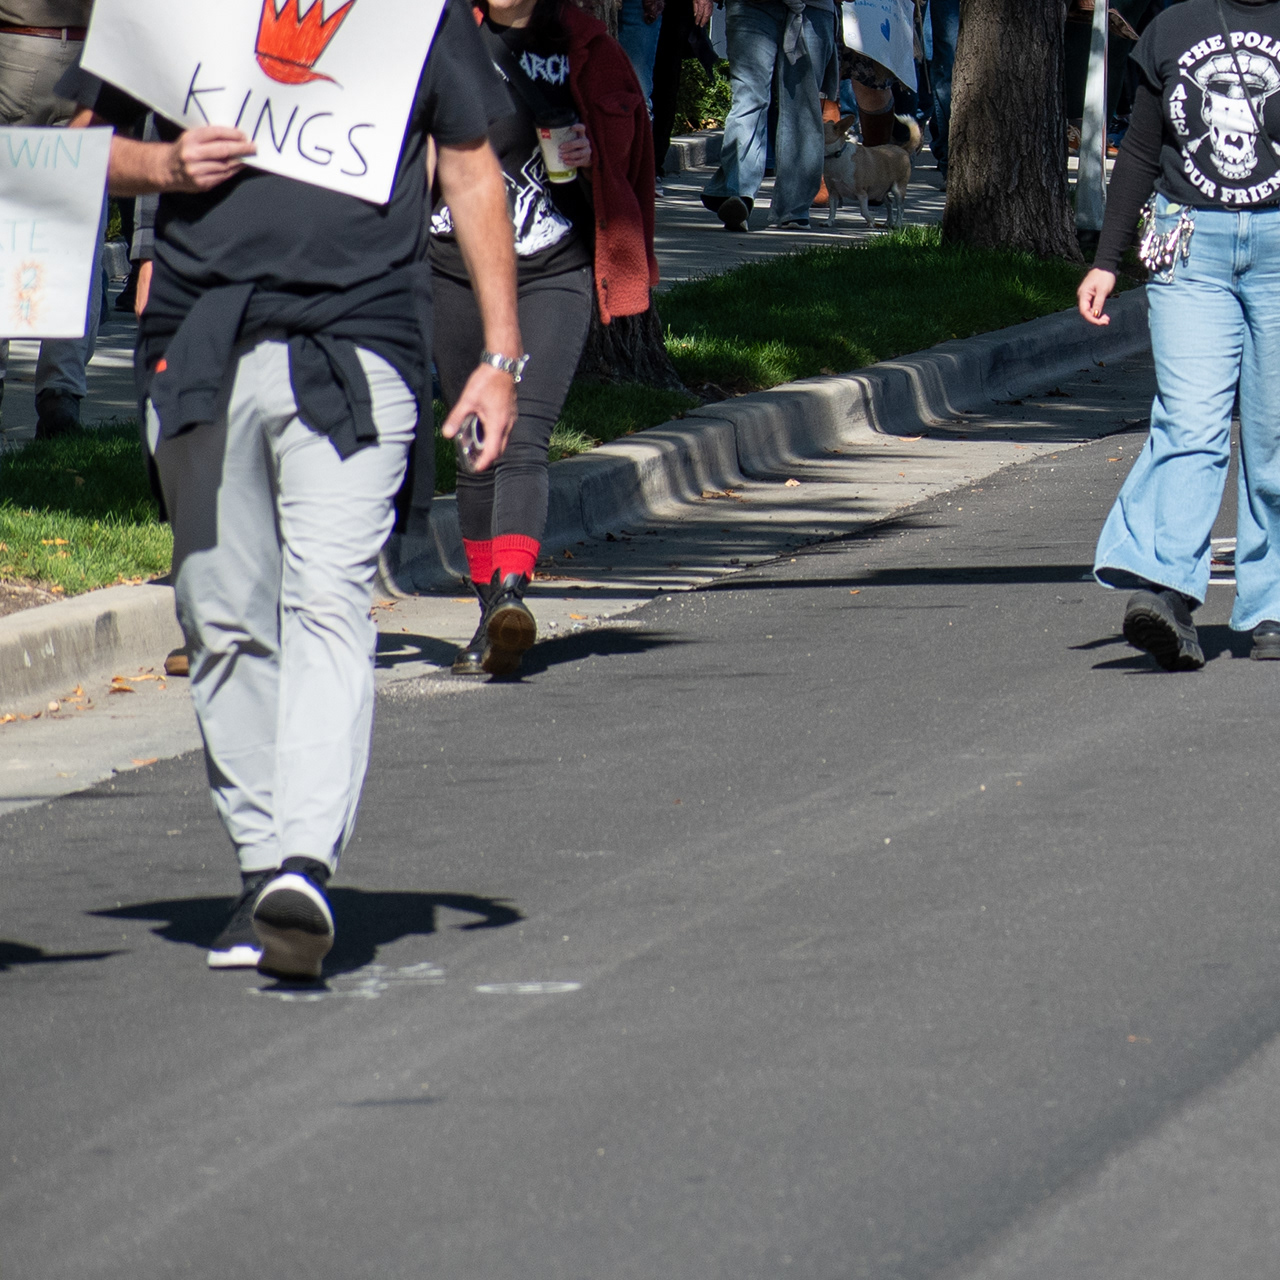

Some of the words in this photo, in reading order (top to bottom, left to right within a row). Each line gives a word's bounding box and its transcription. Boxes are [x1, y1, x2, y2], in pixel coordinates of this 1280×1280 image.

[1178, 34, 1226, 68] THE
[183, 62, 376, 177] KINGS
[1169, 83, 1190, 136] ARE
